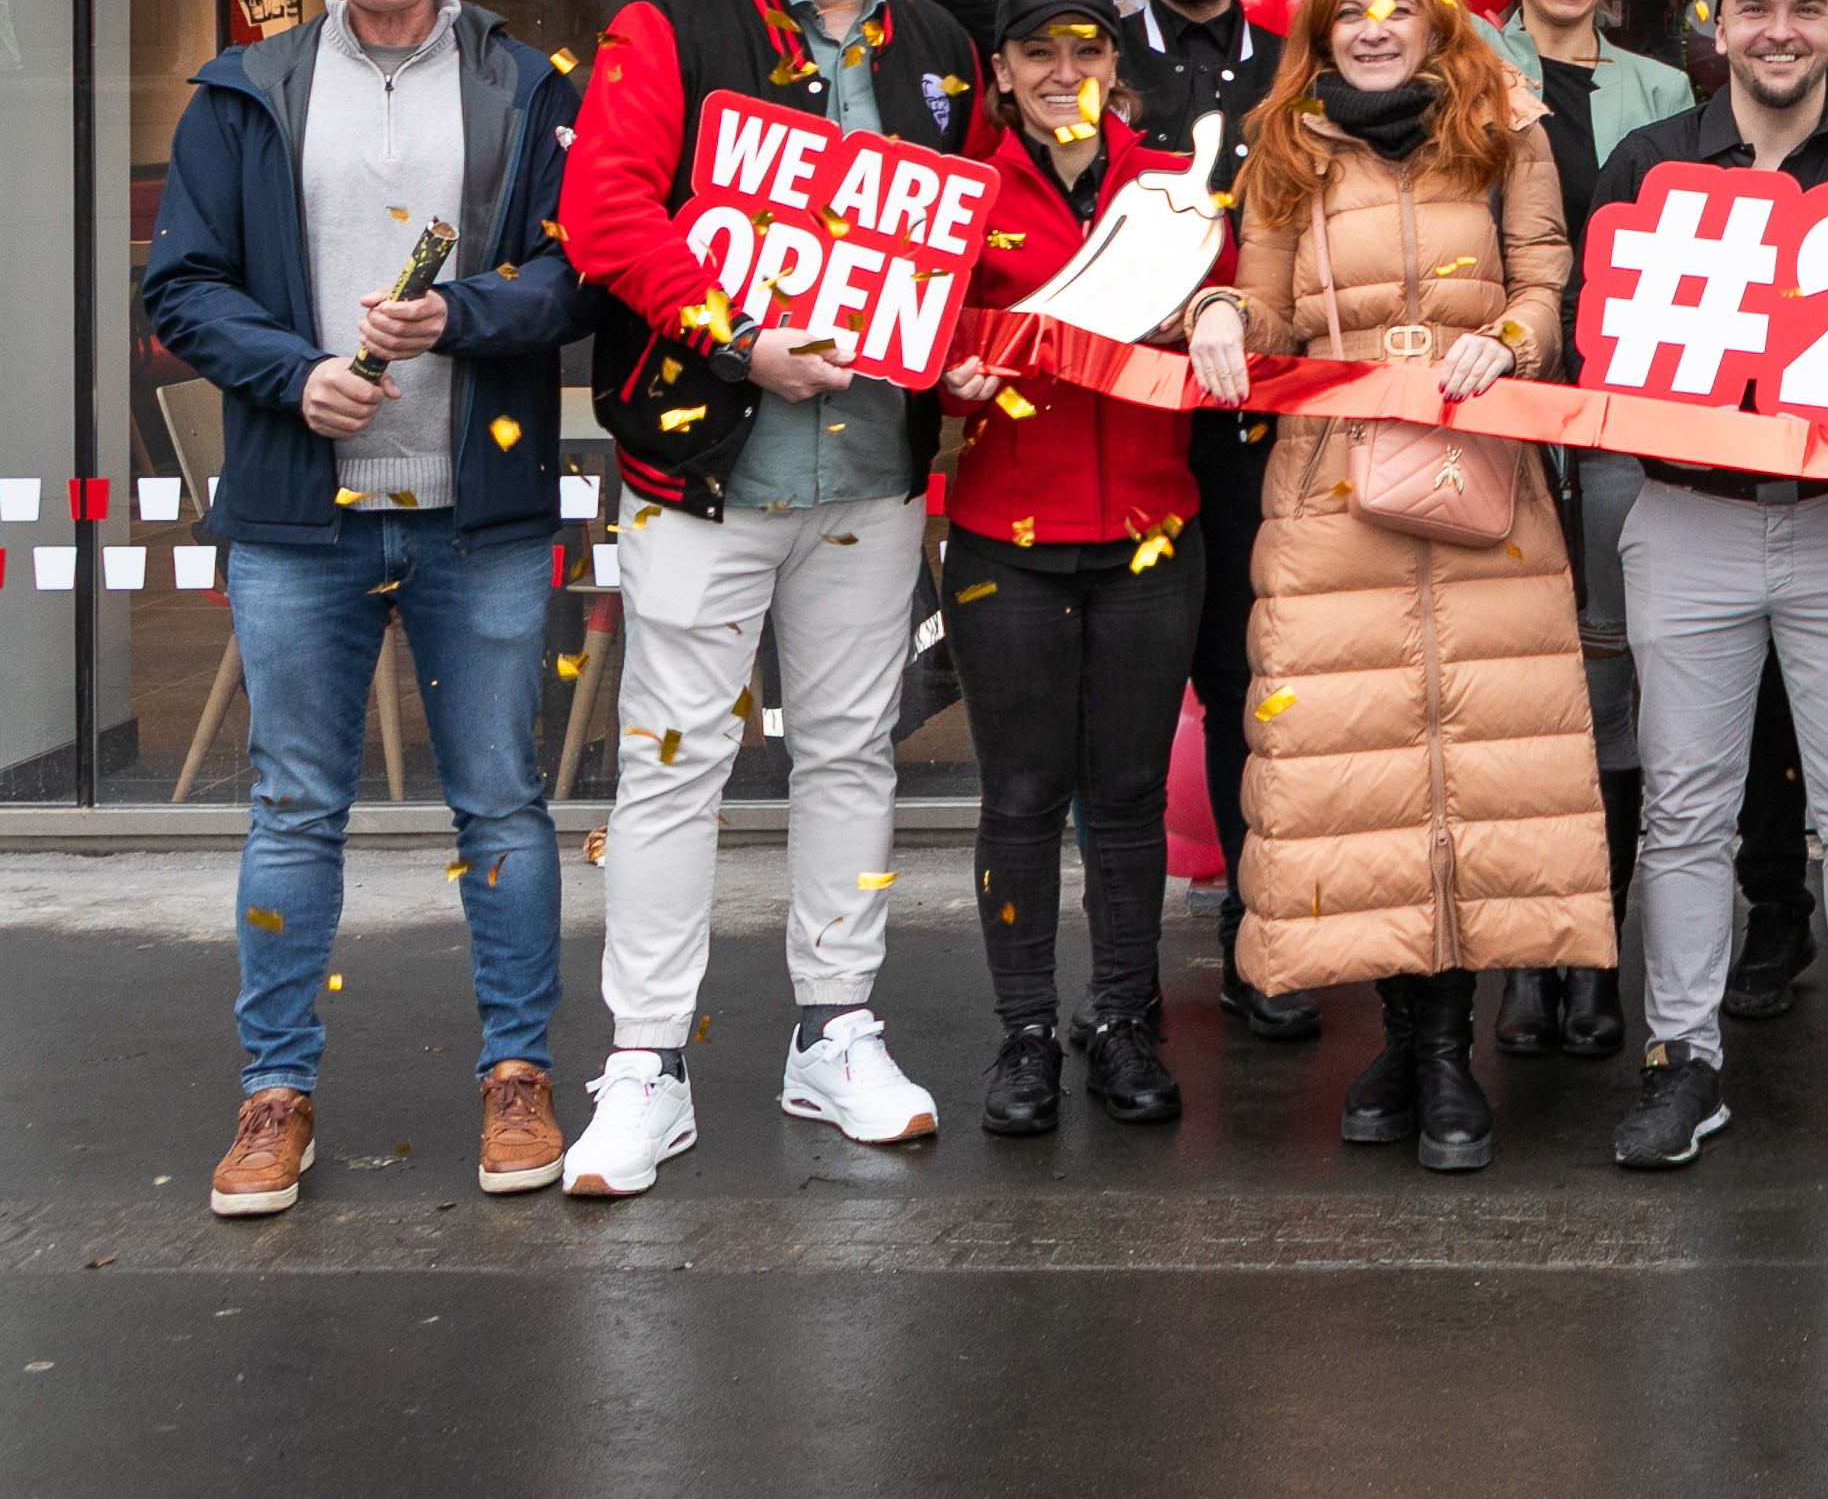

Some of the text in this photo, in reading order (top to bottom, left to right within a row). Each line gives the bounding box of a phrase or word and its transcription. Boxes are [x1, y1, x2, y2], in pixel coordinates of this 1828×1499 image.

[712, 108, 985, 255] WE ARE
[687, 206, 954, 372] OPEN
